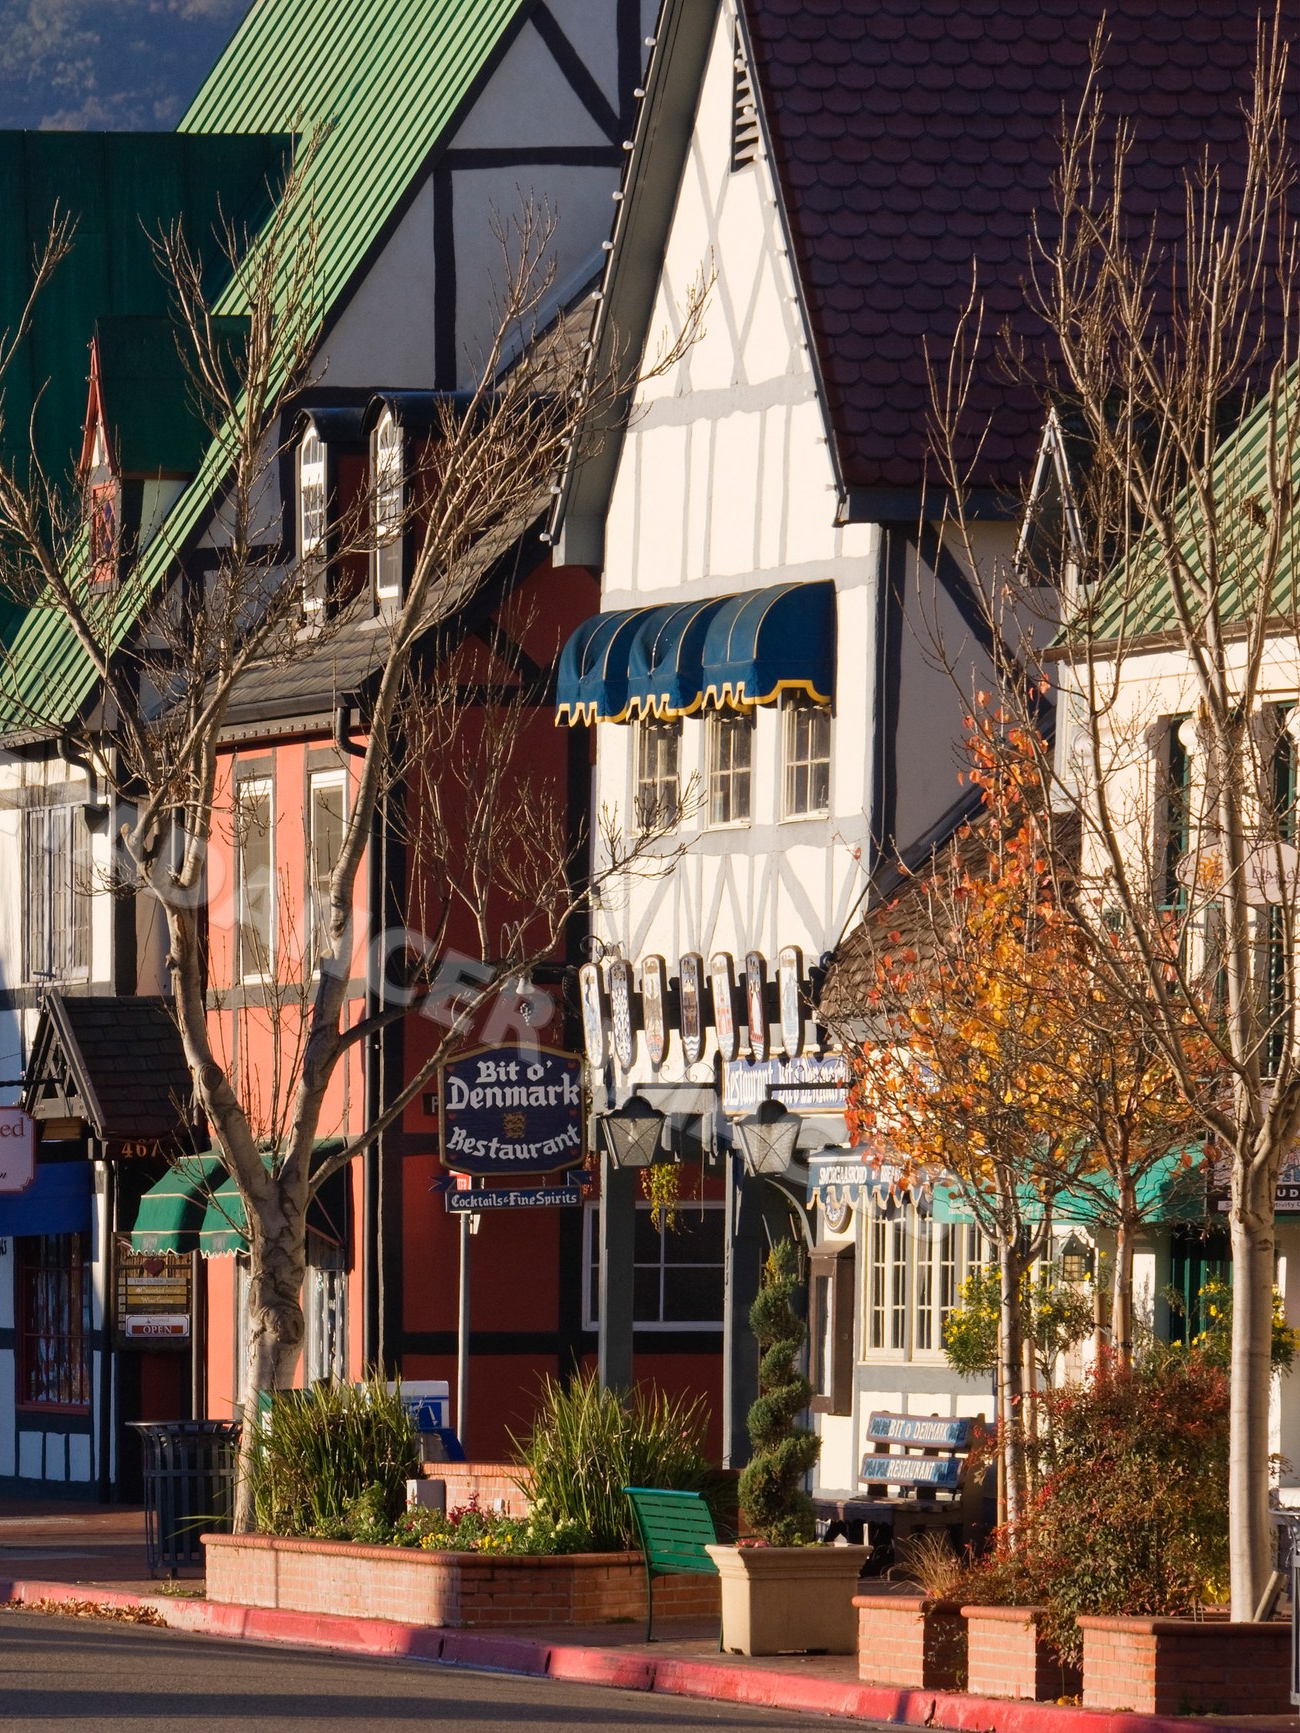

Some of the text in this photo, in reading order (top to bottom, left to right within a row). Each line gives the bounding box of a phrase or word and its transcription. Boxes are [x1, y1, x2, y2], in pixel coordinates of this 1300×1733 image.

[475, 1060, 553, 1084] Bit o'
[446, 1072, 581, 1110] Denmark
[121, 1140, 159, 1158] 467
[445, 1123, 581, 1160] Restaurant
[451, 1192, 503, 1208] Cocktails
[509, 1191, 536, 1206] Fine
[536, 1190, 578, 1207] Spirits
[142, 1326, 173, 1334] OPEN
[888, 1419, 906, 1437] BIT
[913, 1422, 950, 1441] DENMARK
[886, 1459, 936, 1480] RESTAURANT
